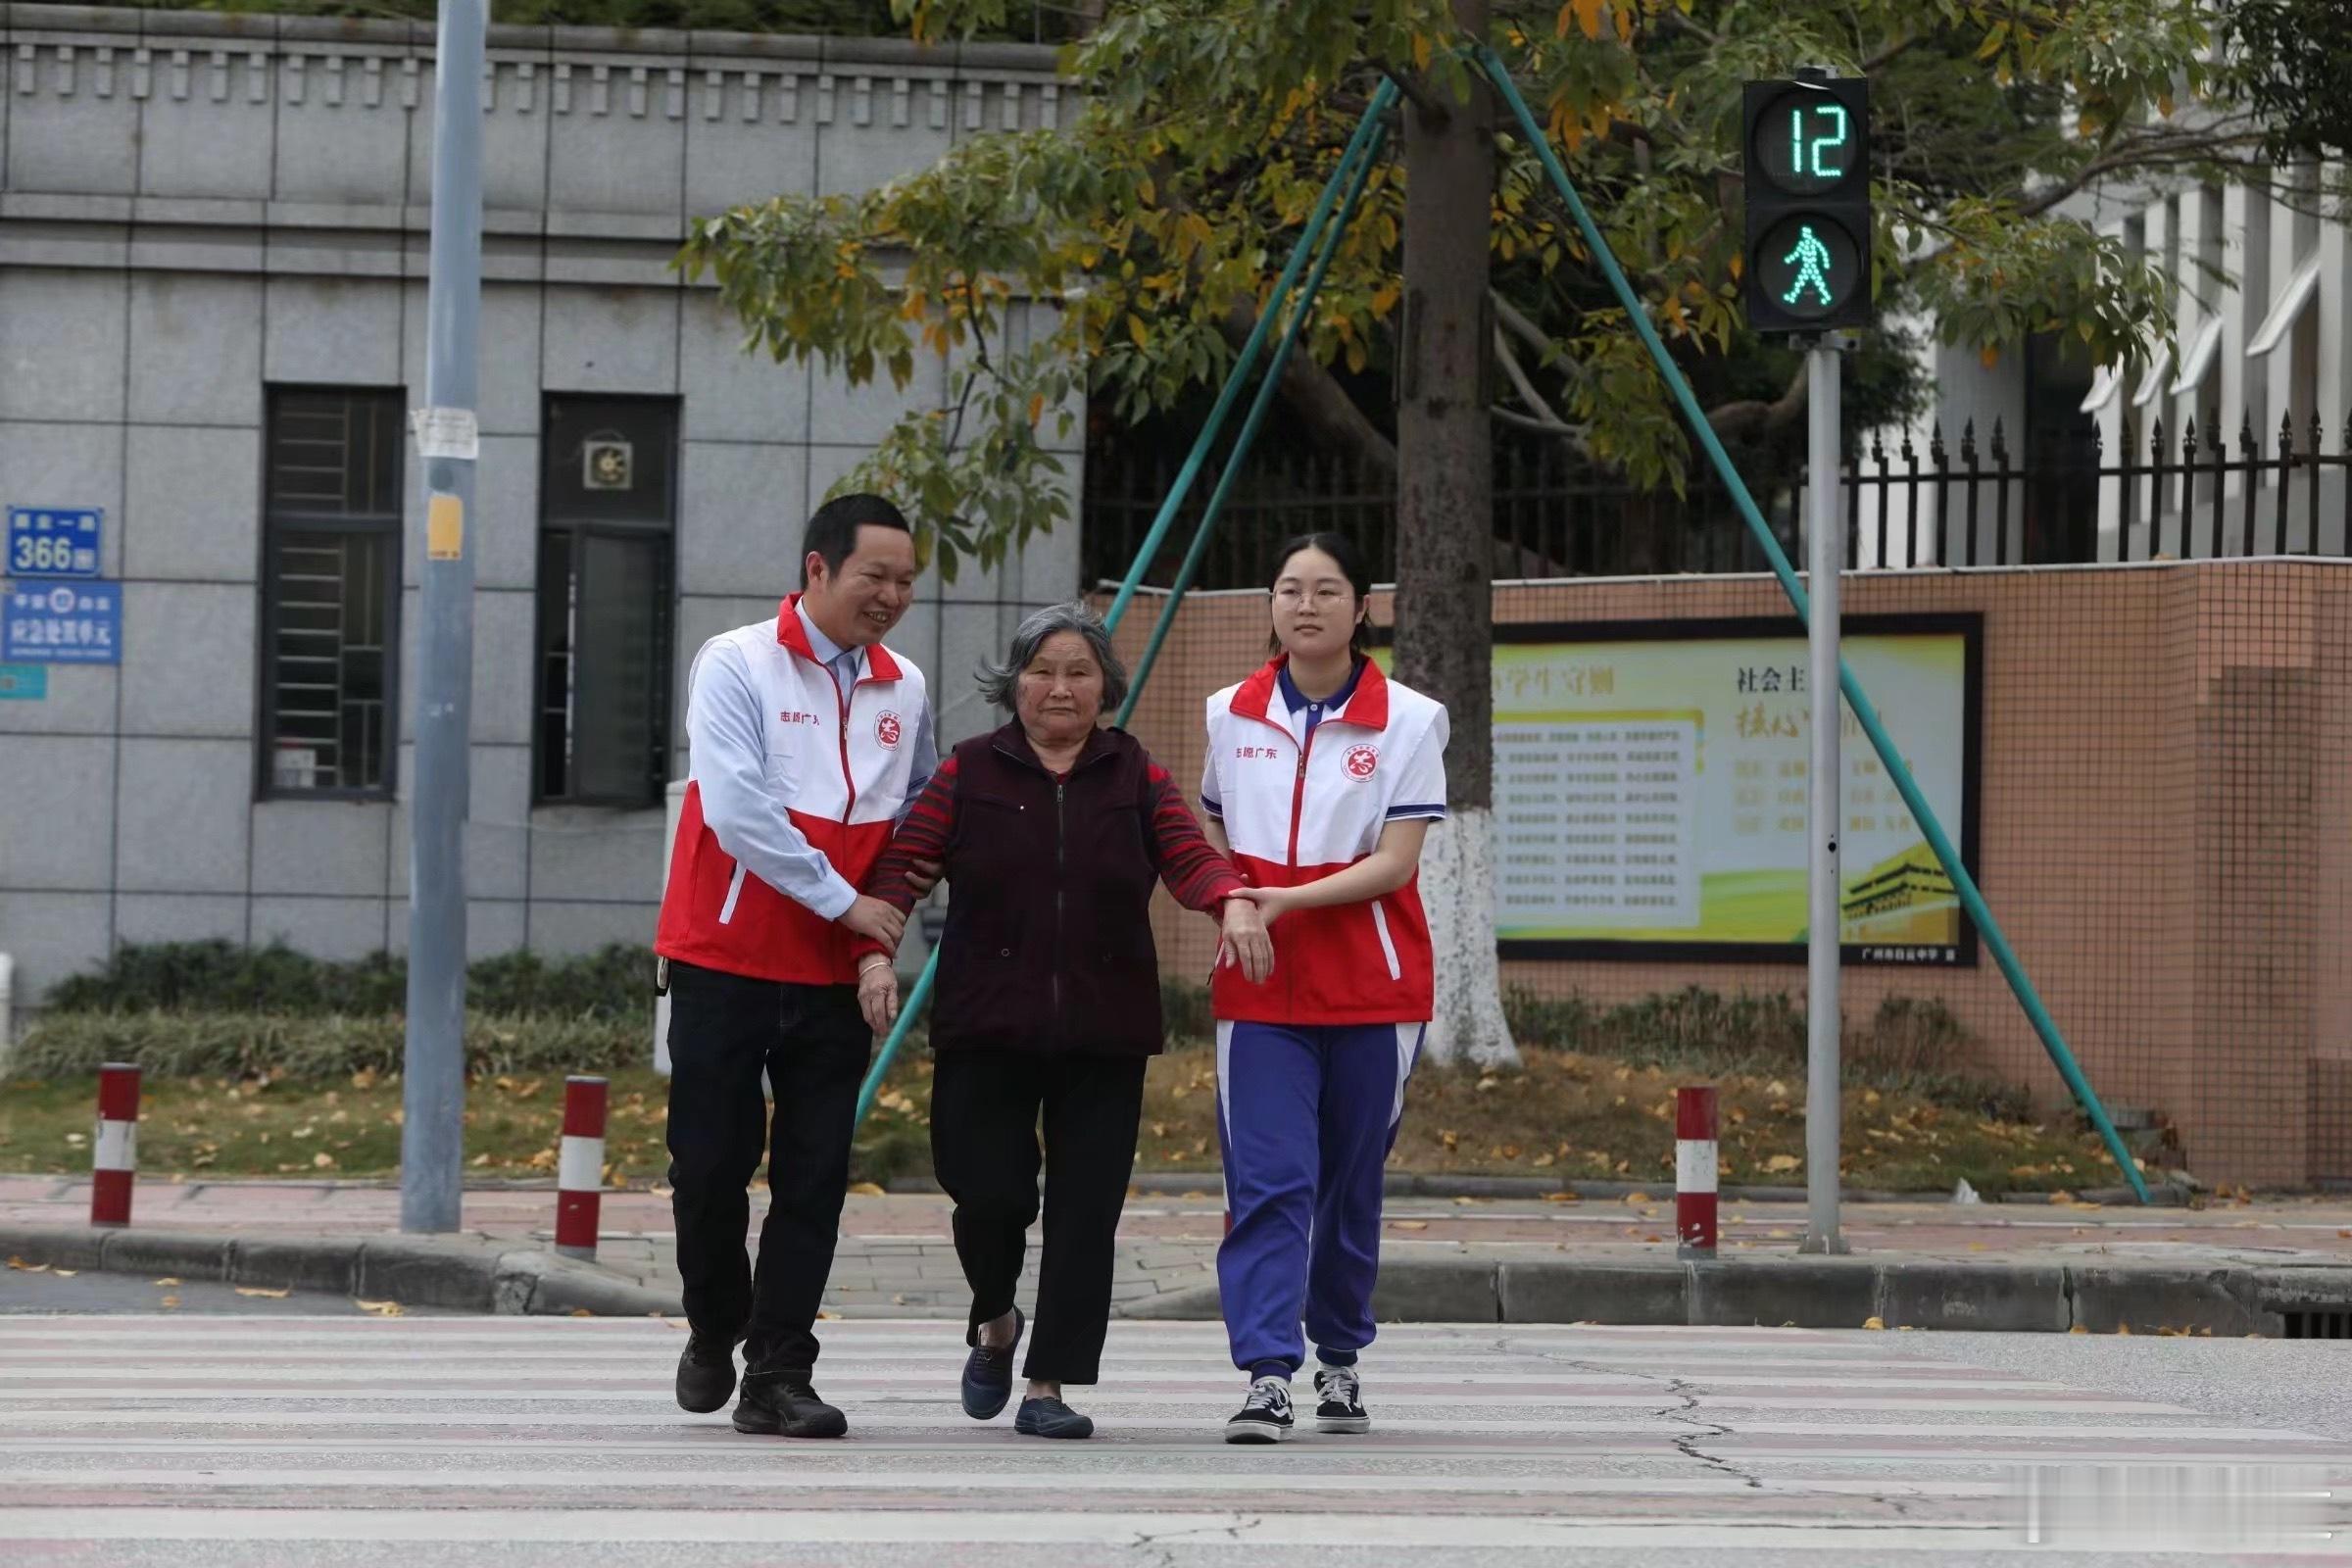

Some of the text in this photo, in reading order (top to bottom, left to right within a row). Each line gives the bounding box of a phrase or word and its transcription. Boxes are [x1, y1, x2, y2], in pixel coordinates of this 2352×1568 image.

[1792, 106, 1845, 176] 12
[15, 536, 71, 569] 366
[1738, 665, 1806, 693] 社会主
